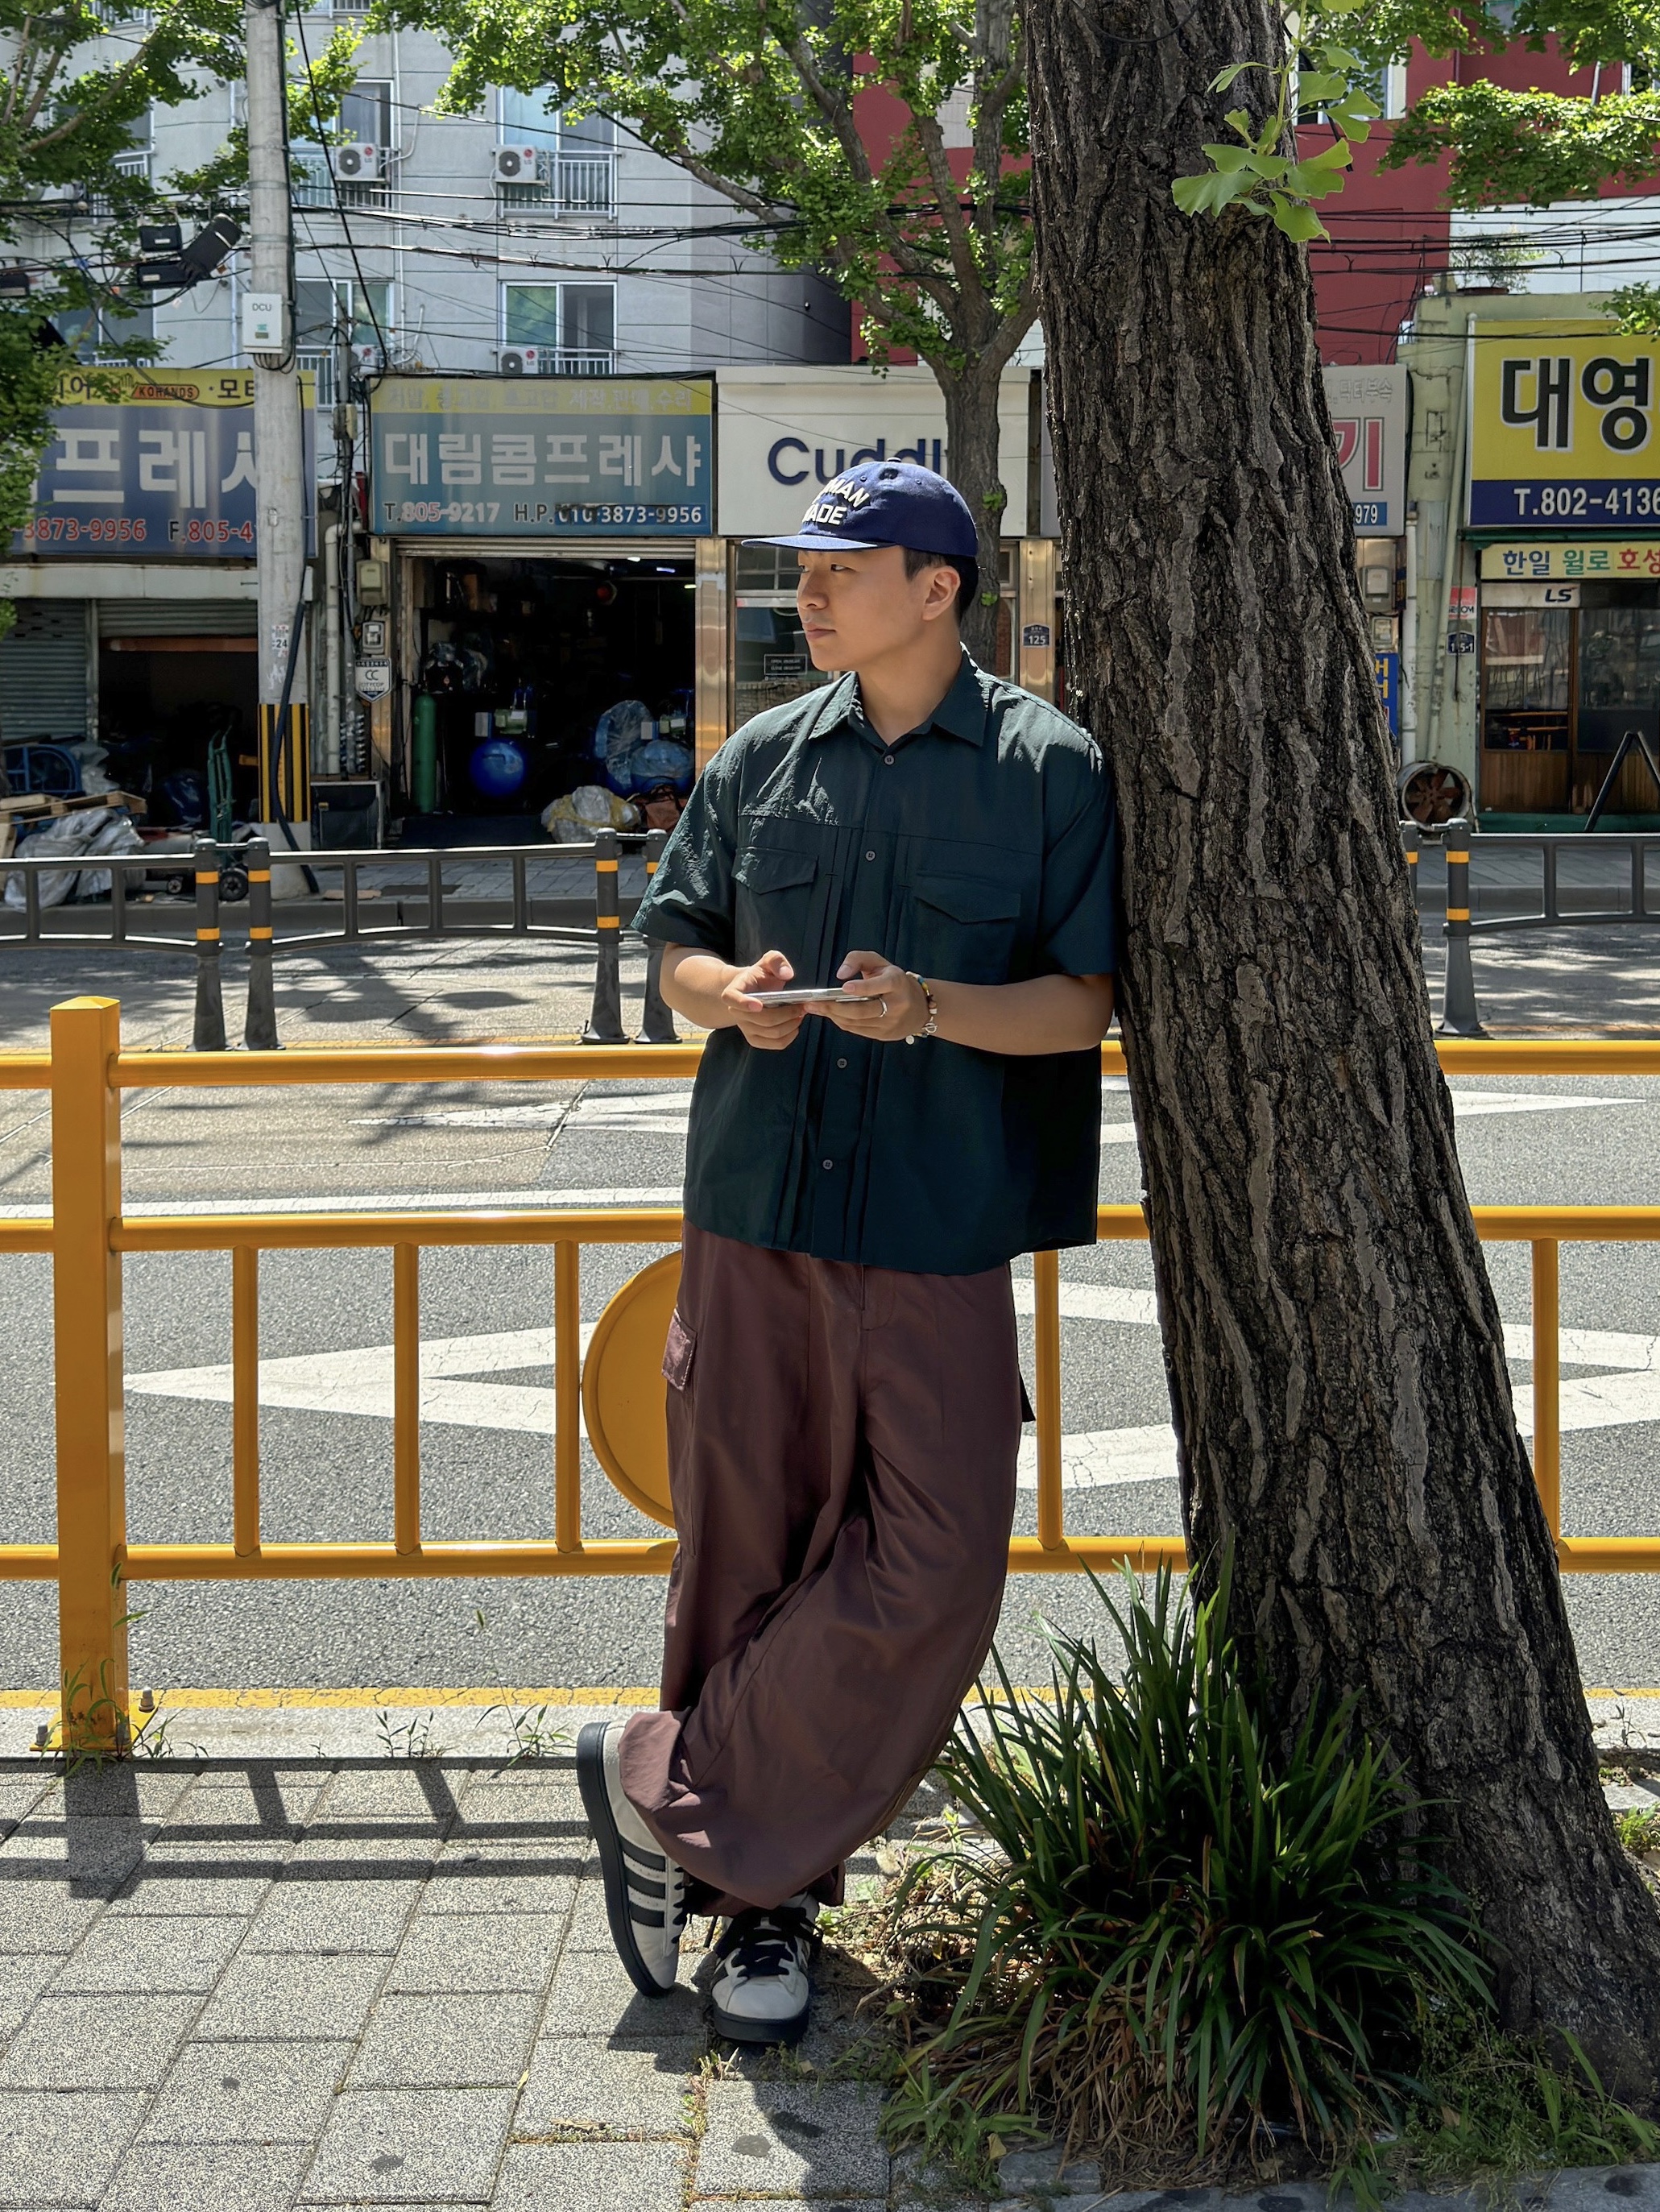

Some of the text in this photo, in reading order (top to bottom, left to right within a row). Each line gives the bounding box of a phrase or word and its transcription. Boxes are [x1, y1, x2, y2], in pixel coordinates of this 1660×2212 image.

[252, 303, 272, 312] DCU
[1501, 356, 1660, 452] 대영
[52, 428, 256, 508] 프레
[384, 433, 702, 487] 대림콤프레샤
[768, 437, 948, 487] Cuddl
[812, 478, 870, 507] MAN
[802, 503, 847, 525] ADE
[168, 520, 255, 543] F.805-4
[1502, 549, 1550, 576] 한일
[1544, 588, 1572, 603] LS
[1028, 635, 1046, 645] 125
[1450, 642, 1473, 652] 15-1
